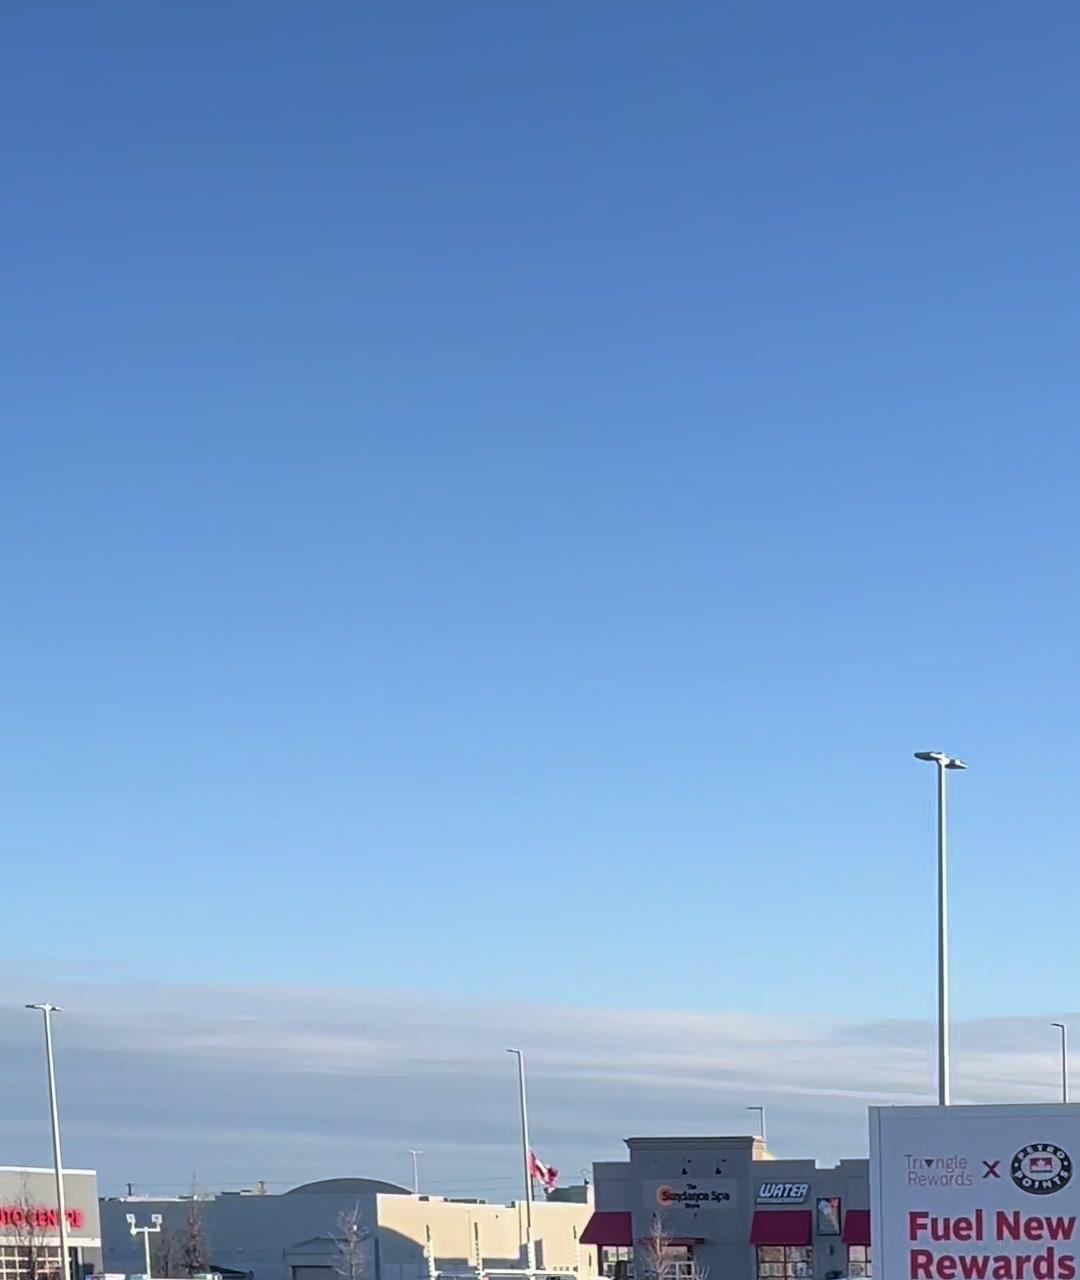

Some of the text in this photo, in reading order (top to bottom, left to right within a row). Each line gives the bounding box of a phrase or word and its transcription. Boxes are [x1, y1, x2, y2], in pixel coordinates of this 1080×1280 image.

[1017, 1145, 1065, 1160] PETRO
[907, 1171, 973, 1187] Rewards
[1015, 1170, 1069, 1189] POINTS
[711, 1190, 730, 1203] Spa
[759, 1183, 809, 1198] WATER
[909, 1208, 1077, 1242] Fuel New
[910, 1246, 1077, 1280] Rewards
